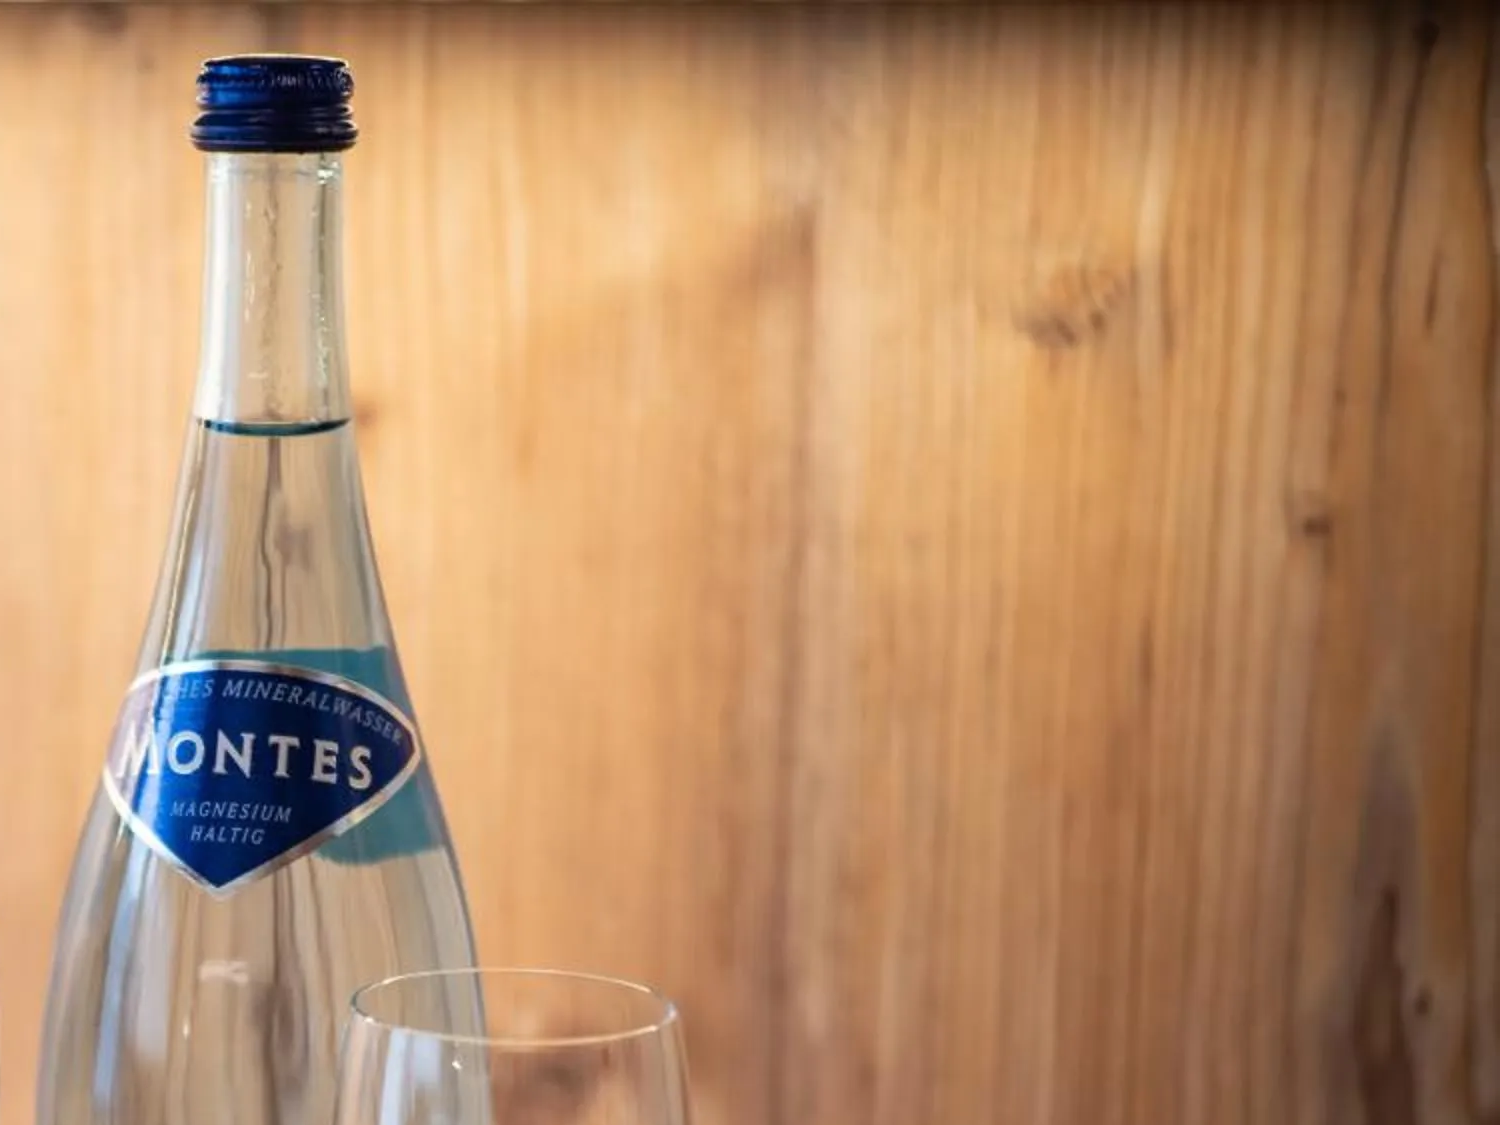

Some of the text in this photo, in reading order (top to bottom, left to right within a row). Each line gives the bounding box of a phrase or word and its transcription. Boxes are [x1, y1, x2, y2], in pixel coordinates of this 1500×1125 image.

[172, 678, 402, 746] HES MINERALWASSER
[115, 715, 374, 790] MONTES
[169, 801, 293, 824] MAGNESIUM
[190, 826, 266, 846] HALTIG
